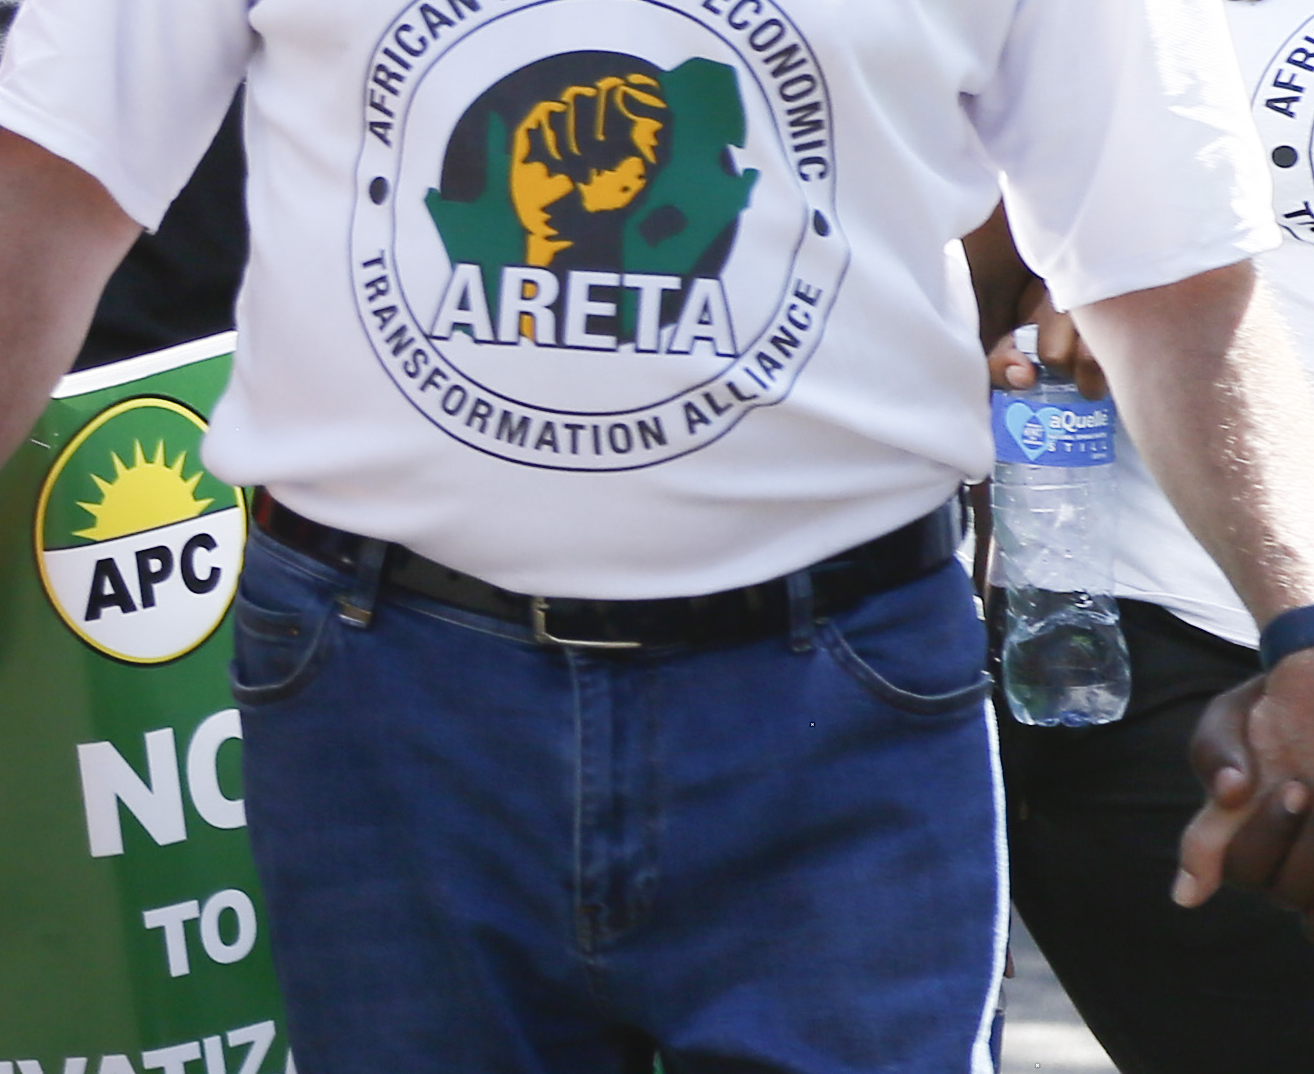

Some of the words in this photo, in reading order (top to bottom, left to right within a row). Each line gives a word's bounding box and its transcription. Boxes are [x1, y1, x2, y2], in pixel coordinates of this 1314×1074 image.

[361, 249, 669, 456] TRANSFORMATION
[681, 277, 824, 436] ALLIANCE
[426, 262, 740, 358] ARETA
[84, 533, 222, 622] APC
[143, 888, 257, 977] TO
